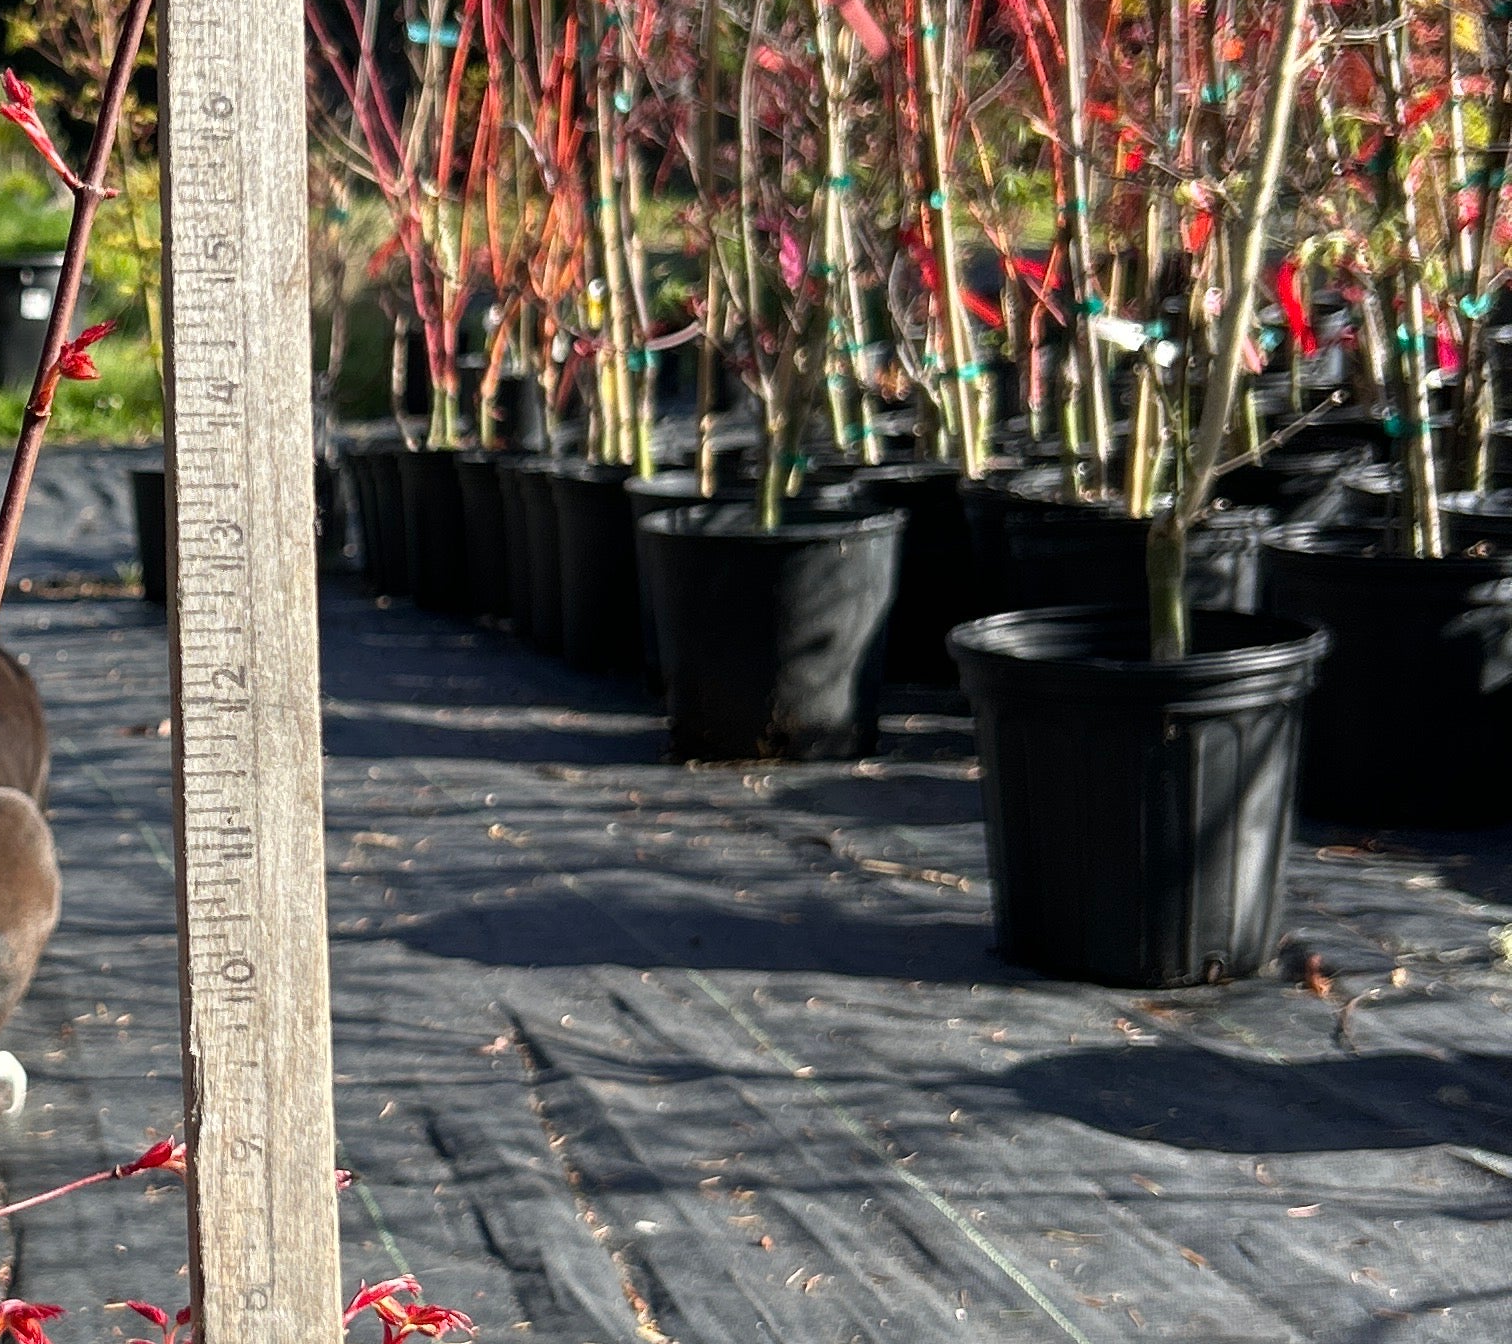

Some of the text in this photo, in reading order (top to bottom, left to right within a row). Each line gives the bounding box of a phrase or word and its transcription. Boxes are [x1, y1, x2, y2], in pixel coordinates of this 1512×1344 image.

[201, 94, 234, 141] 16
[203, 239, 237, 283] 15
[207, 381, 240, 427] 14
[209, 522, 244, 570] 13
[211, 665, 247, 713] 12
[221, 958, 255, 1003] 10
